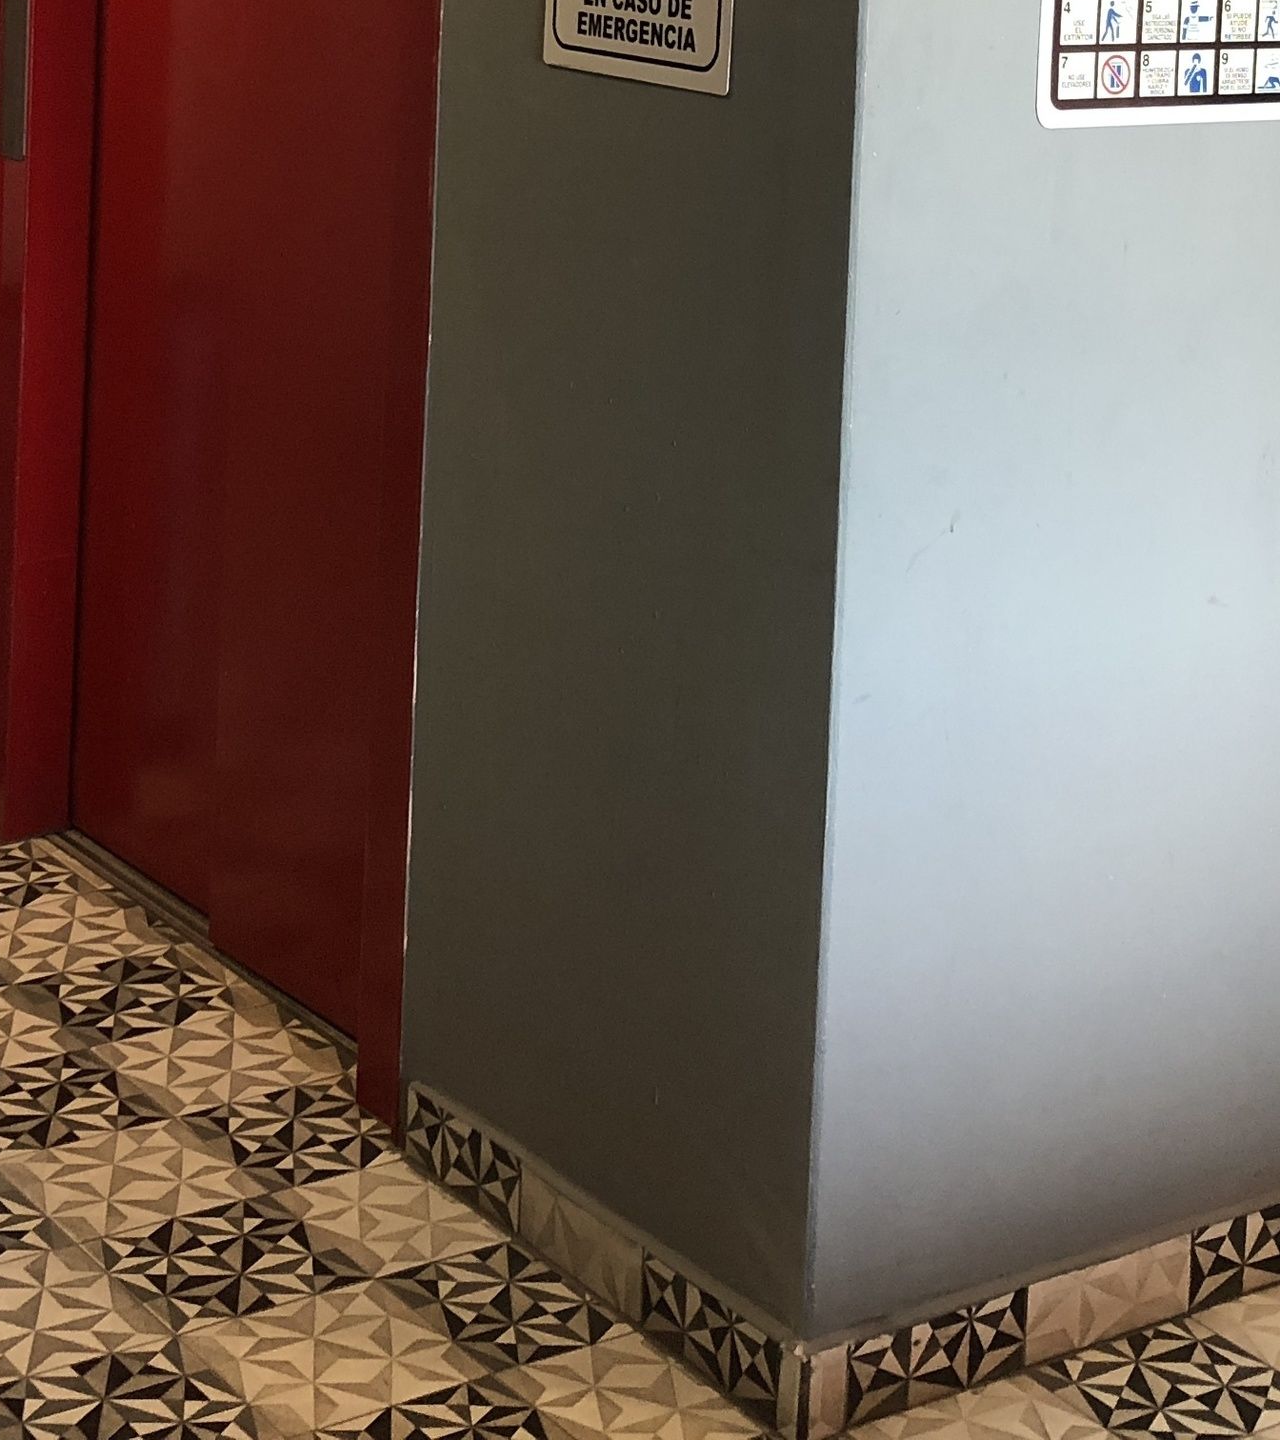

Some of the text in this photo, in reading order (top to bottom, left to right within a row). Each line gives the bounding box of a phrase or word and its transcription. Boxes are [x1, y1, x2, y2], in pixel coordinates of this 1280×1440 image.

[1064, 2, 1071, 13] 4
[1145, 1, 1153, 13] 5
[1224, 0, 1231, 12] 6
[577, 11, 696, 53] EMERGENCIA
[1062, 56, 1069, 69] 7
[1143, 54, 1150, 67] 8
[1221, 53, 1229, 65] 9
